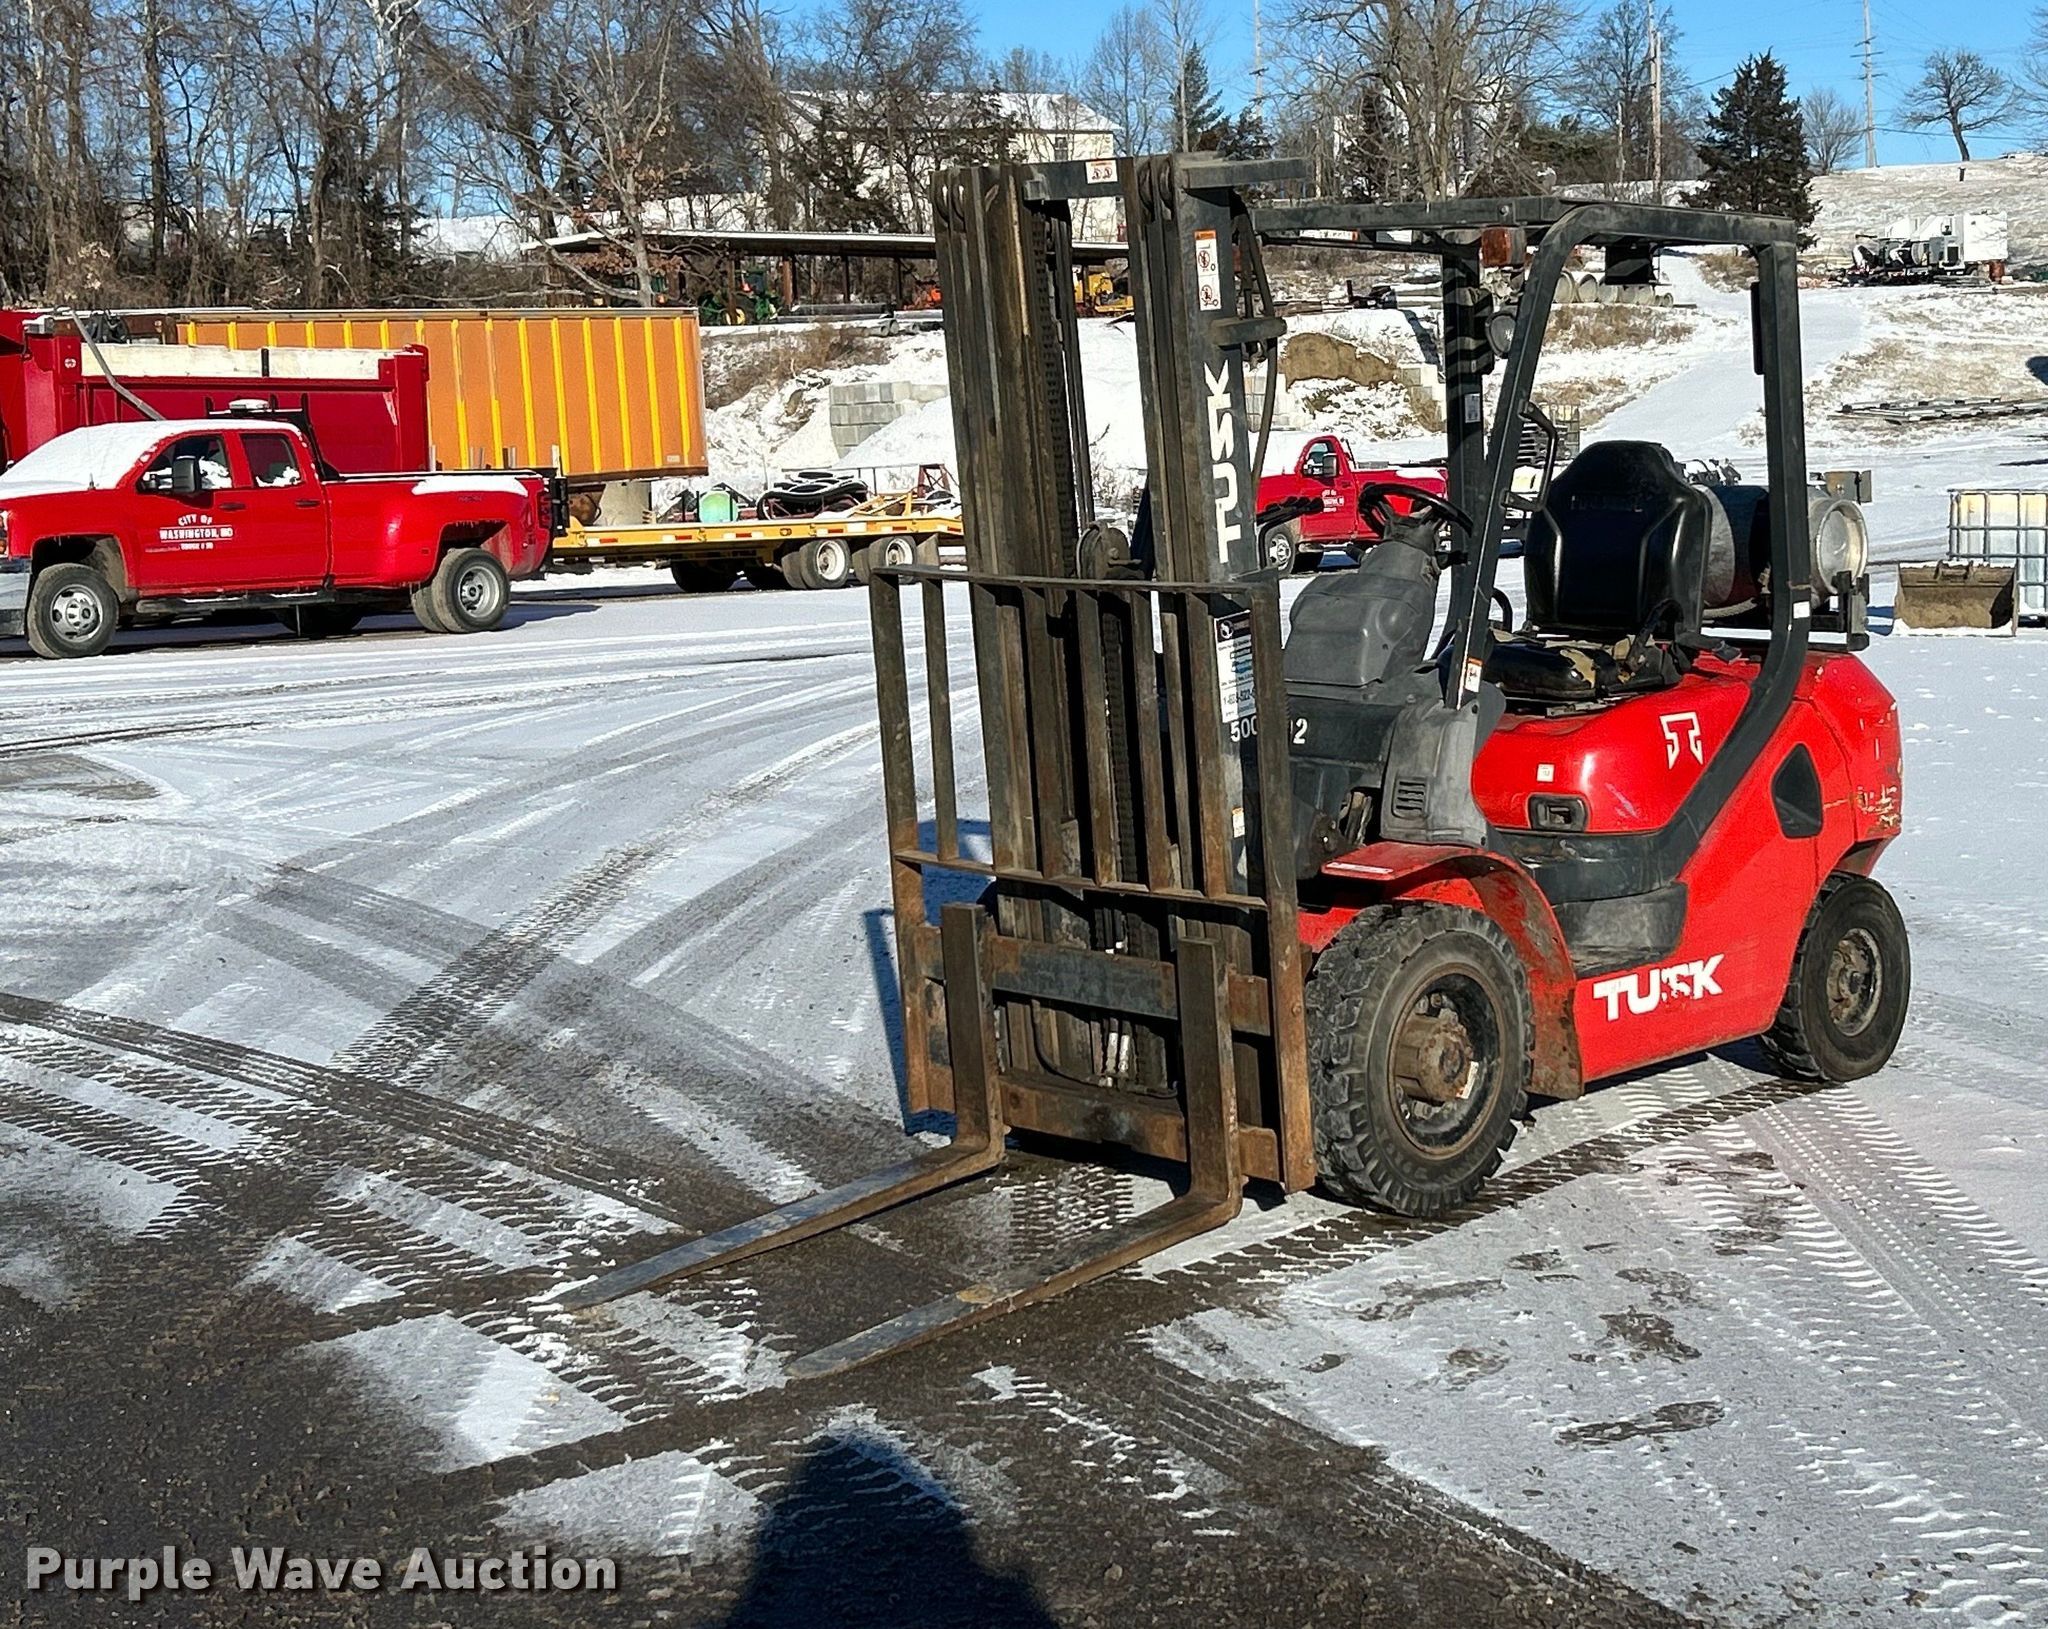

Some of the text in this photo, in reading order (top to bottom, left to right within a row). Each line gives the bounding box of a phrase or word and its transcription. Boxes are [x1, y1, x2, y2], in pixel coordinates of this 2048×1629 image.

[1204, 359, 1241, 564] TUSK
[178, 514, 197, 526] CITY
[1593, 953, 1725, 1022] TUSK
